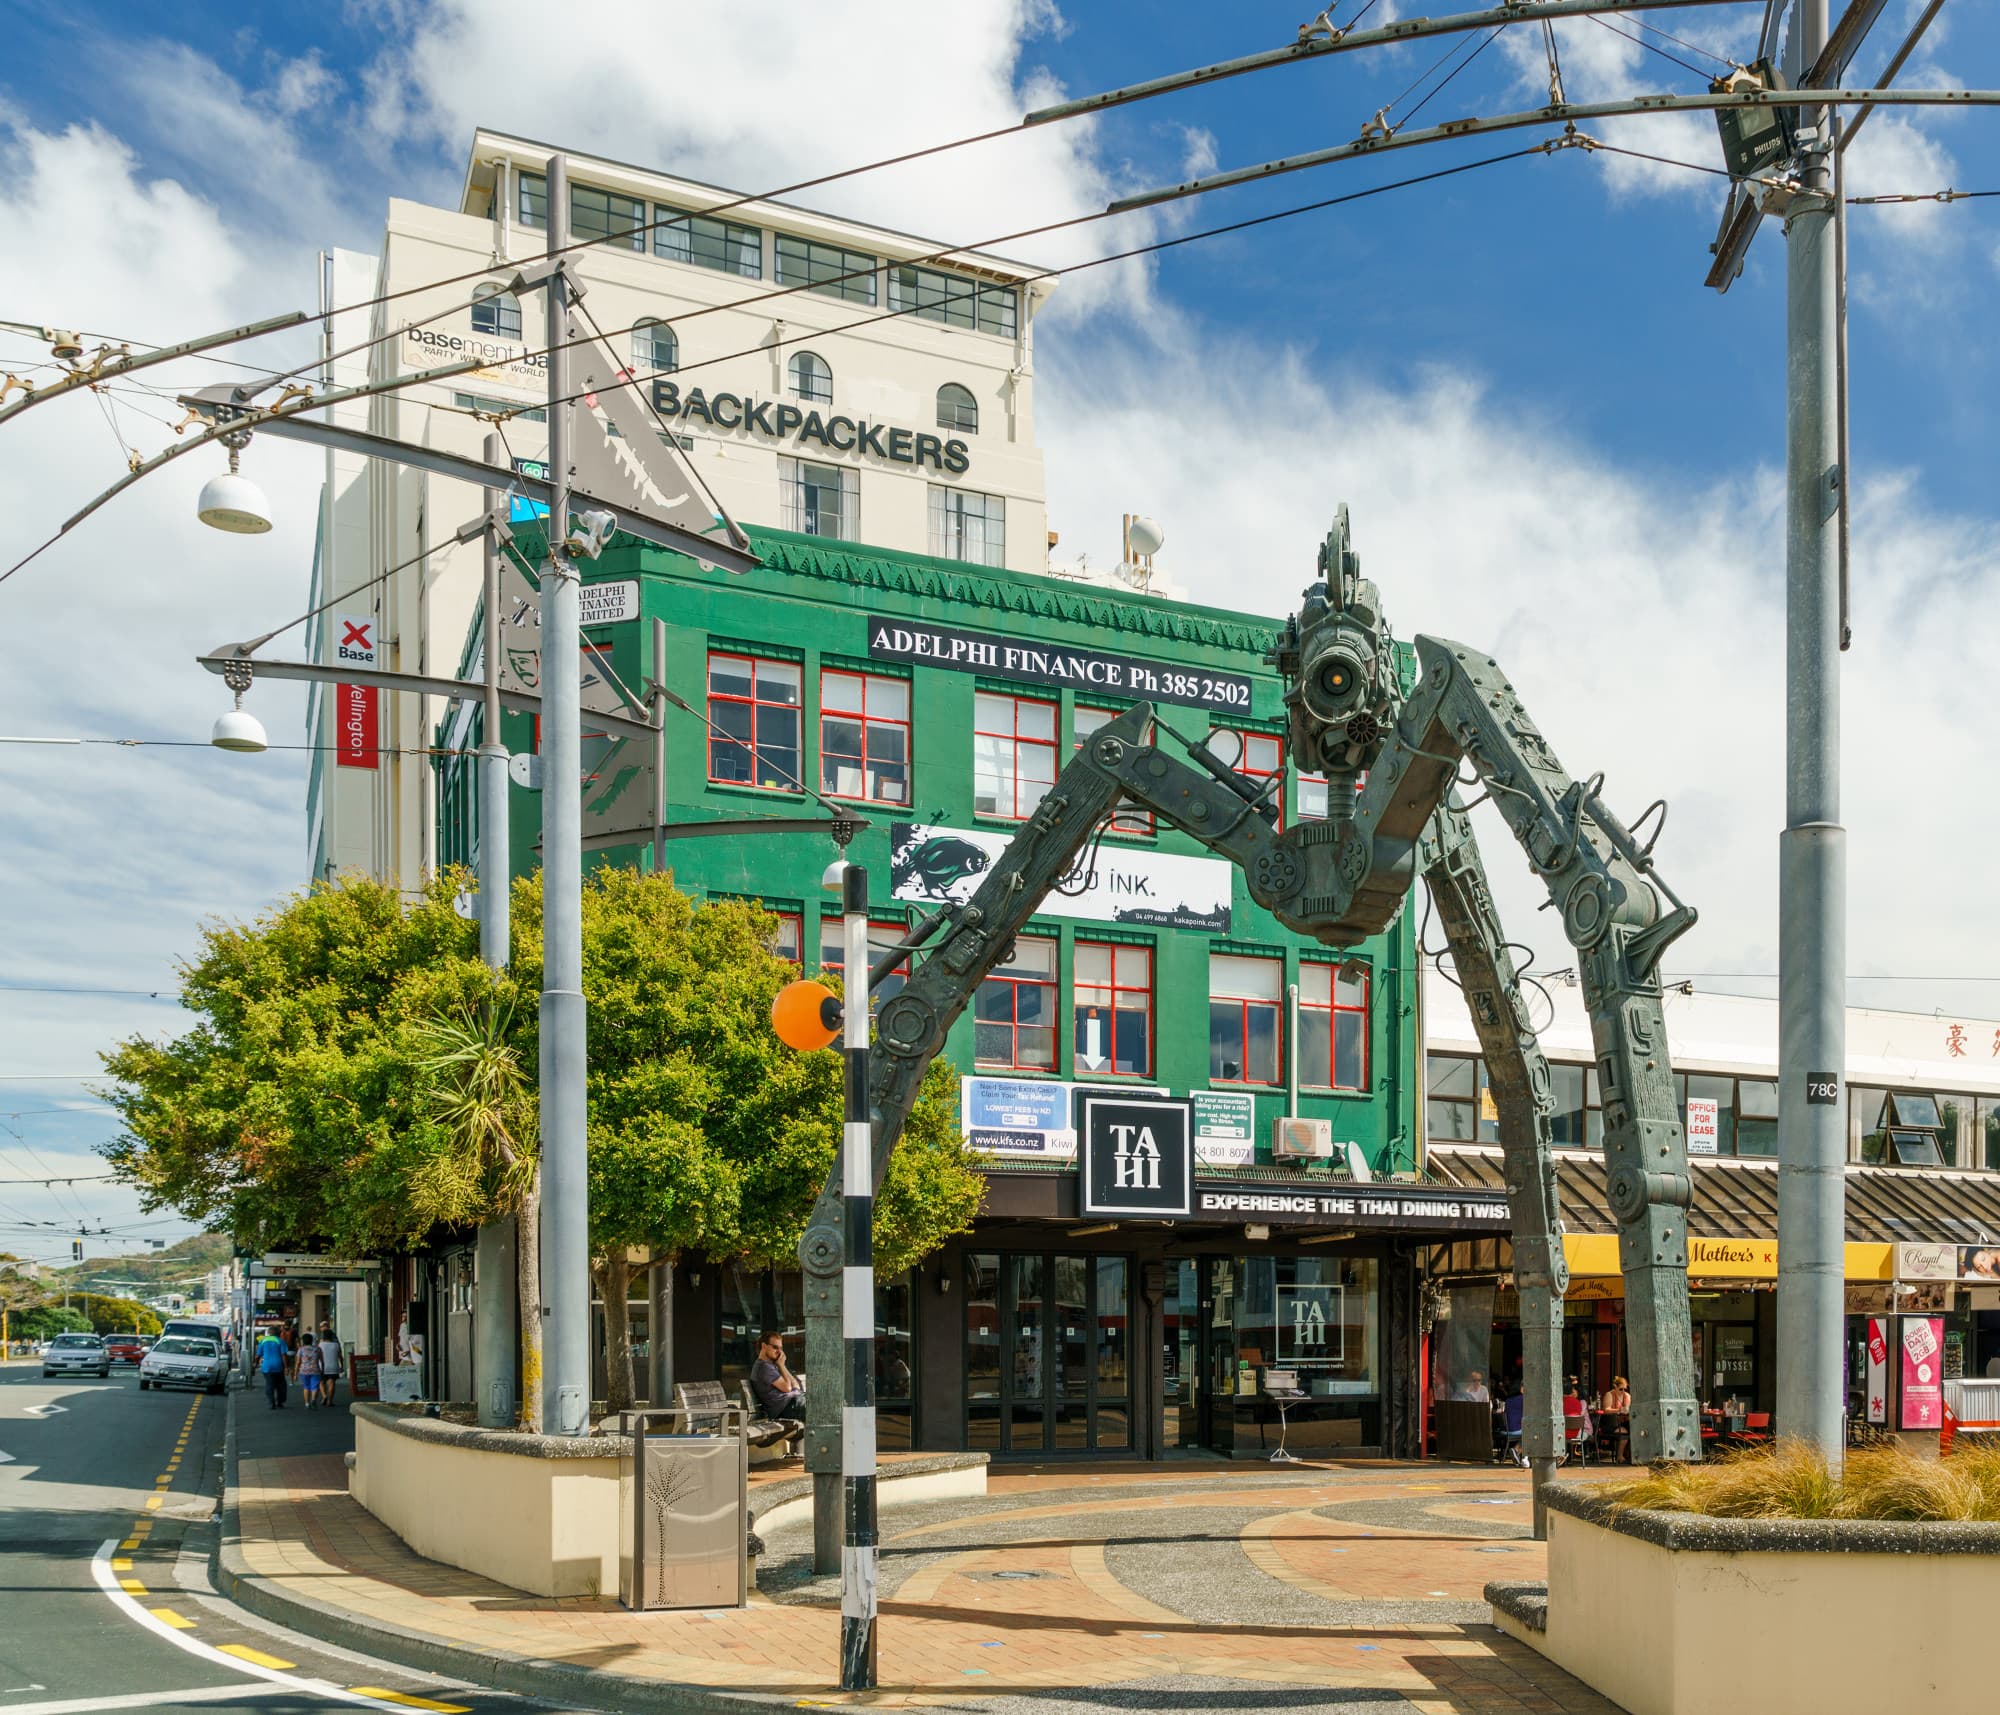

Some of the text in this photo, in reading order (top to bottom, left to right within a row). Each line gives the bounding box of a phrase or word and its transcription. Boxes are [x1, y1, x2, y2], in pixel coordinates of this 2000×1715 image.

[1754, 136, 1781, 157] PHILIPS
[408, 328, 549, 369] basement ba
[424, 347, 455, 359] PARTY
[511, 365, 545, 377] WORLD
[652, 379, 970, 473] BACKPACKERS
[338, 646, 374, 662] Base
[872, 627, 1250, 706] ADELPHI FINANCE Ph 385 2502
[1808, 1083, 1837, 1097] 78C
[1689, 1103, 1716, 1112] OFFICE
[1694, 1114, 1710, 1123] FOR
[1689, 1125, 1715, 1135] LEASE
[975, 1136, 1073, 1149] www.kfs.co.nz Kiwi
[1209, 1147, 1225, 1156] 801
[1229, 1148, 1250, 1158] 8071
[1201, 1194, 1316, 1213] EXPERIENCE
[1318, 1198, 1355, 1214] THE
[1358, 1200, 1398, 1216] THAI
[1400, 1201, 1460, 1218] DINING
[1688, 1242, 1754, 1263] Mother's
[1904, 1247, 1943, 1270] Royal
[1904, 1323, 1928, 1341] DOUBLE
[1914, 1346, 1930, 1361] 2GB
